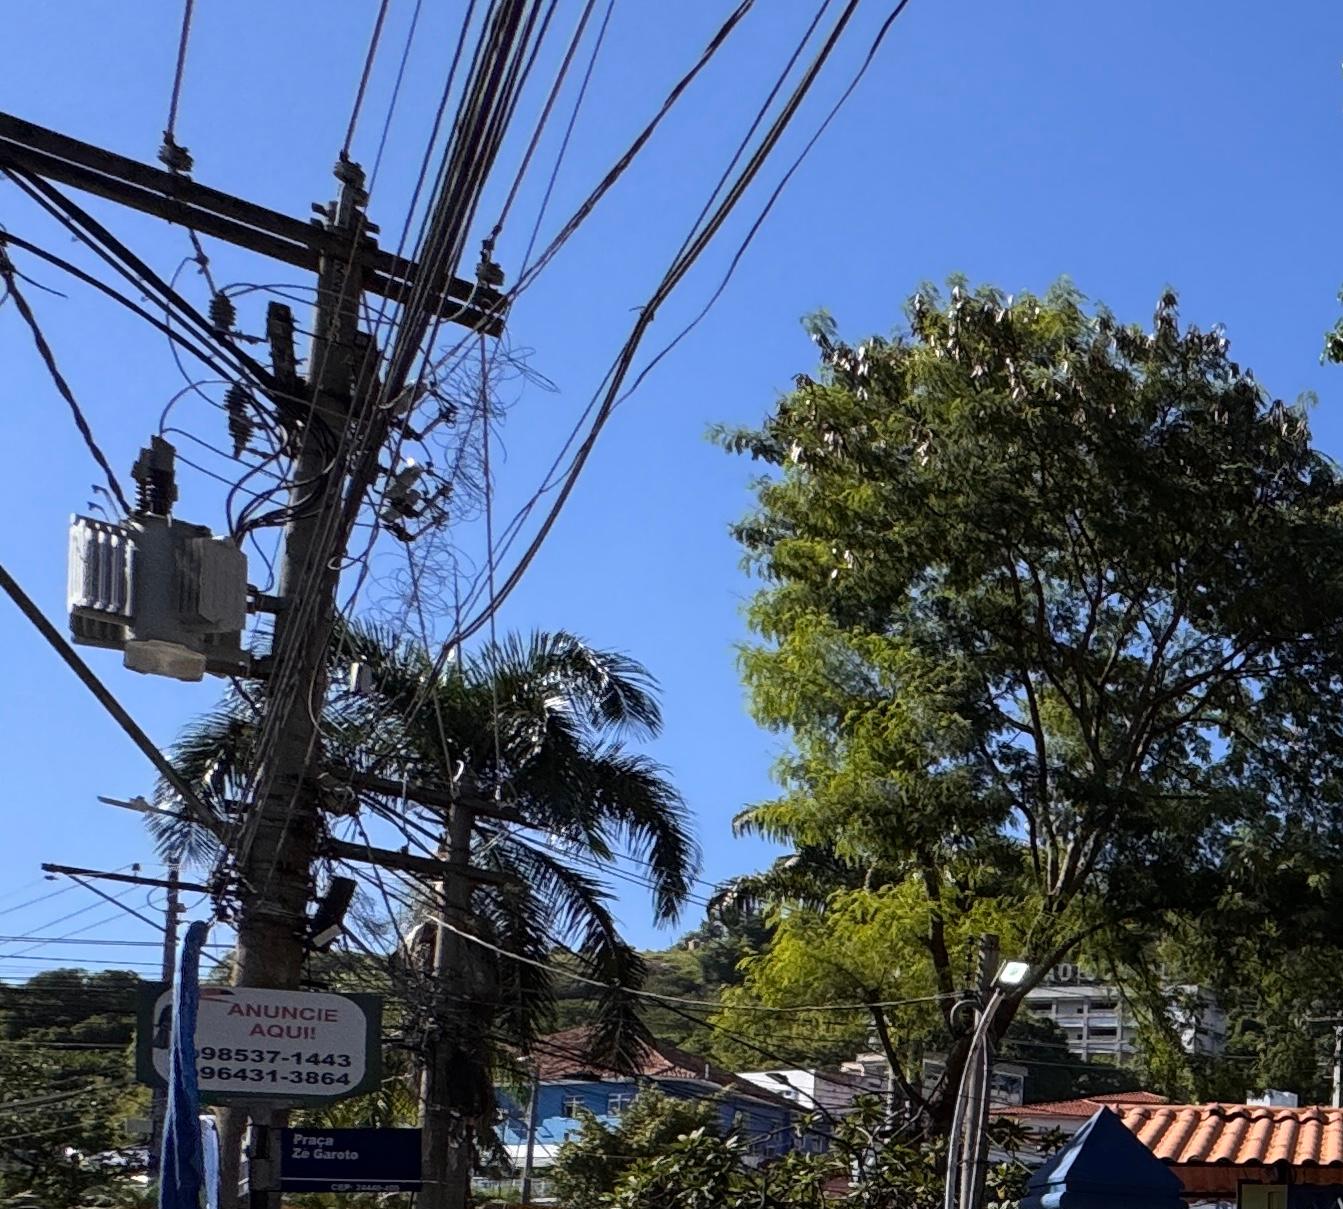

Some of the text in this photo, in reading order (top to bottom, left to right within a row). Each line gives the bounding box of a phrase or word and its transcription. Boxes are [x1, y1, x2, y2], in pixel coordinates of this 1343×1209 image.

[228, 1003, 339, 1022] ANUNCIE
[249, 1023, 316, 1041] AQUI!
[196, 1046, 352, 1068] 98537-1443
[199, 1066, 351, 1086] 96431-3864
[293, 1134, 335, 1148] Praça
[314, 1149, 359, 1160] Garoto
